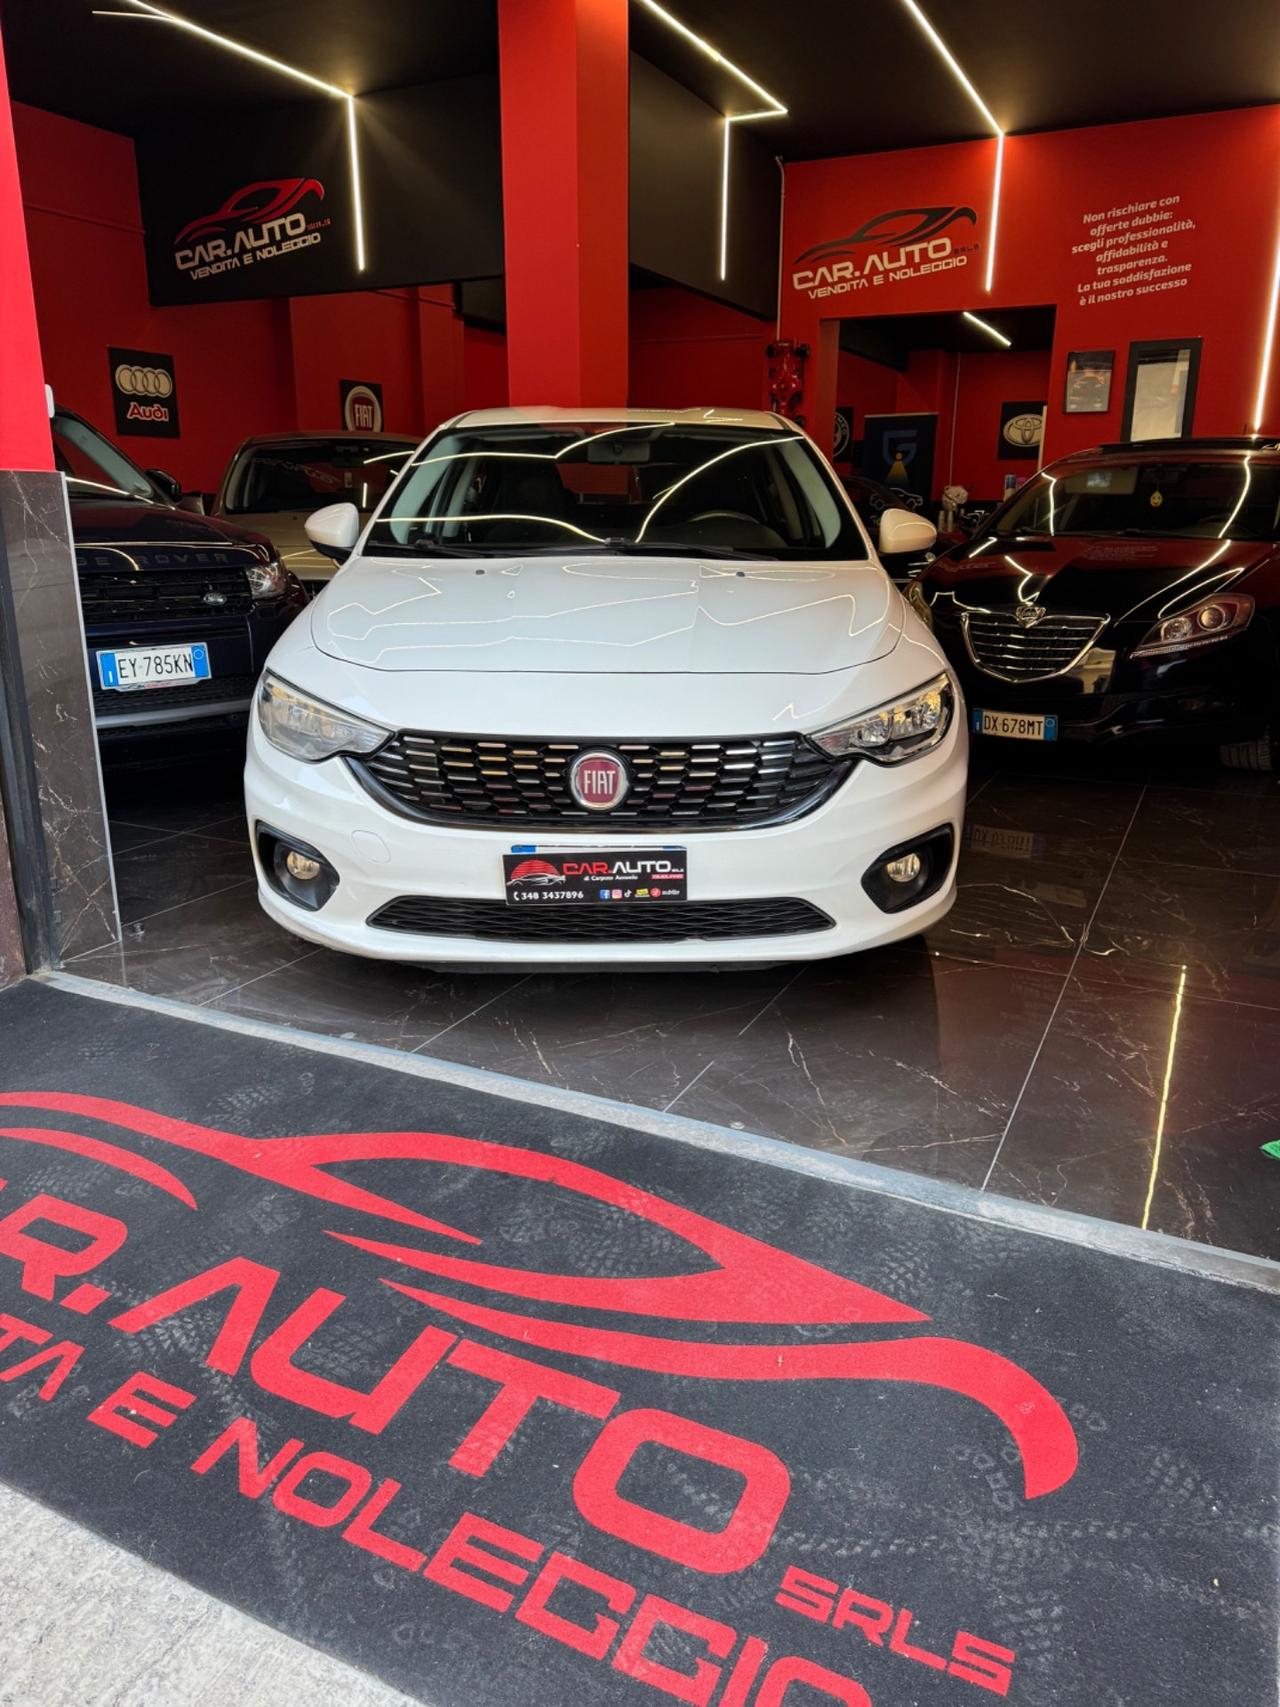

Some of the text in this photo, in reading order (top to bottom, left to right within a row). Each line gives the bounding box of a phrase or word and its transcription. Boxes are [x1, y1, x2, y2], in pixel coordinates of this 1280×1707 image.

[1083, 195, 1180, 224] Non rischiare con
[1072, 219, 1196, 254] scegli professionalità,
[1090, 211, 1173, 237] offerte dubbie:
[175, 213, 306, 270] CAR.AUTO
[1095, 240, 1168, 263] affidabilità e
[190, 232, 321, 280] VENDITA E NOLEGGIO
[792, 237, 951, 290] CAR.AUTO
[1096, 254, 1168, 275] trasparenza.
[808, 255, 967, 299] VENDITA E NOLEGGIO
[1077, 263, 1192, 293] La tua soddisfazione
[1079, 278, 1188, 306] è il nostro successo
[126, 402, 169, 422] Audi
[354, 403, 373, 428] FIAT
[118, 657, 137, 679] EY
[143, 654, 194, 676] 785KN
[984, 714, 999, 731] DX
[1002, 718, 1044, 736] 678MT
[584, 770, 616, 794] FIAT
[562, 860, 671, 875] CAR.AUTO
[521, 890, 584, 900] 348 3437896
[87, 1371, 197, 1449] E
[0, 1178, 1016, 1697] R.AUTO SRLS
